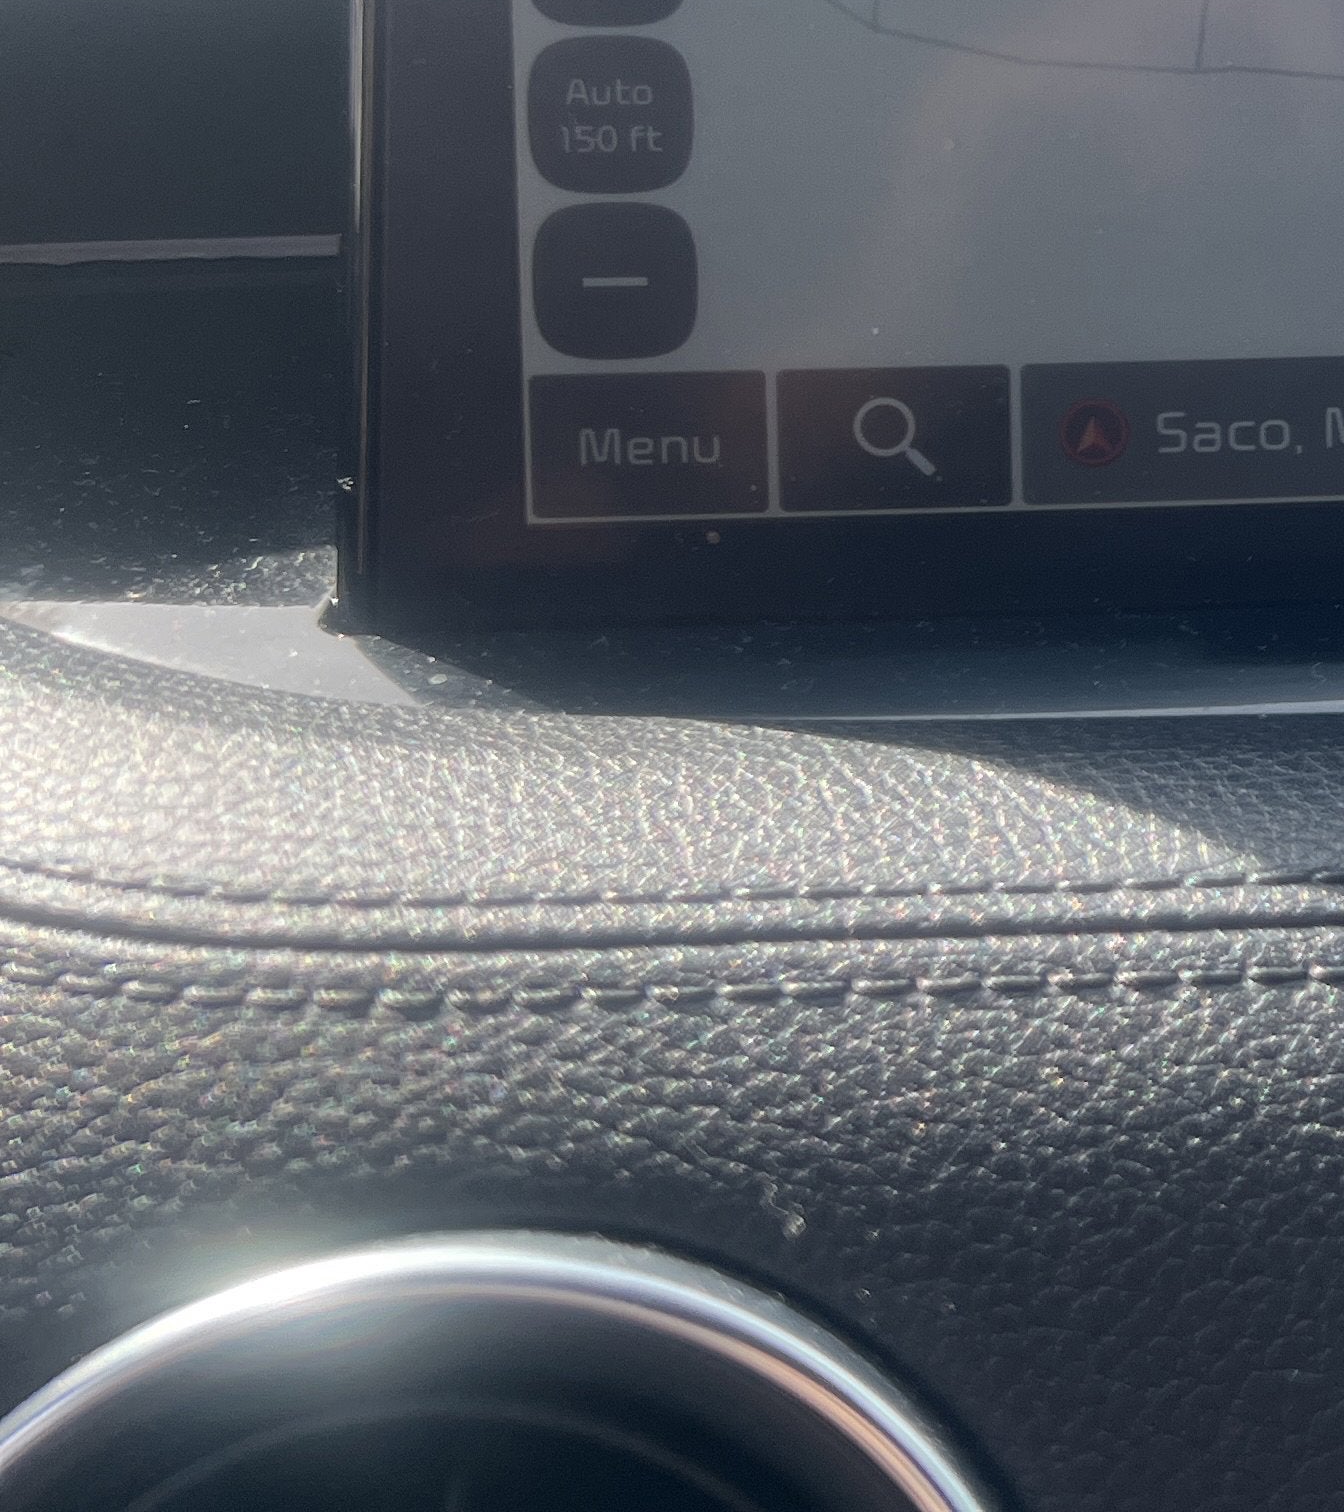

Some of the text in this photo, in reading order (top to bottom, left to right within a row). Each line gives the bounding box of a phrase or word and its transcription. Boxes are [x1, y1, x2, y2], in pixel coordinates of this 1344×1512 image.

[565, 77, 654, 107] Auto
[560, 123, 664, 154] 150 ft
[577, 427, 722, 466] Menu
[1155, 410, 1303, 455] Saco,
